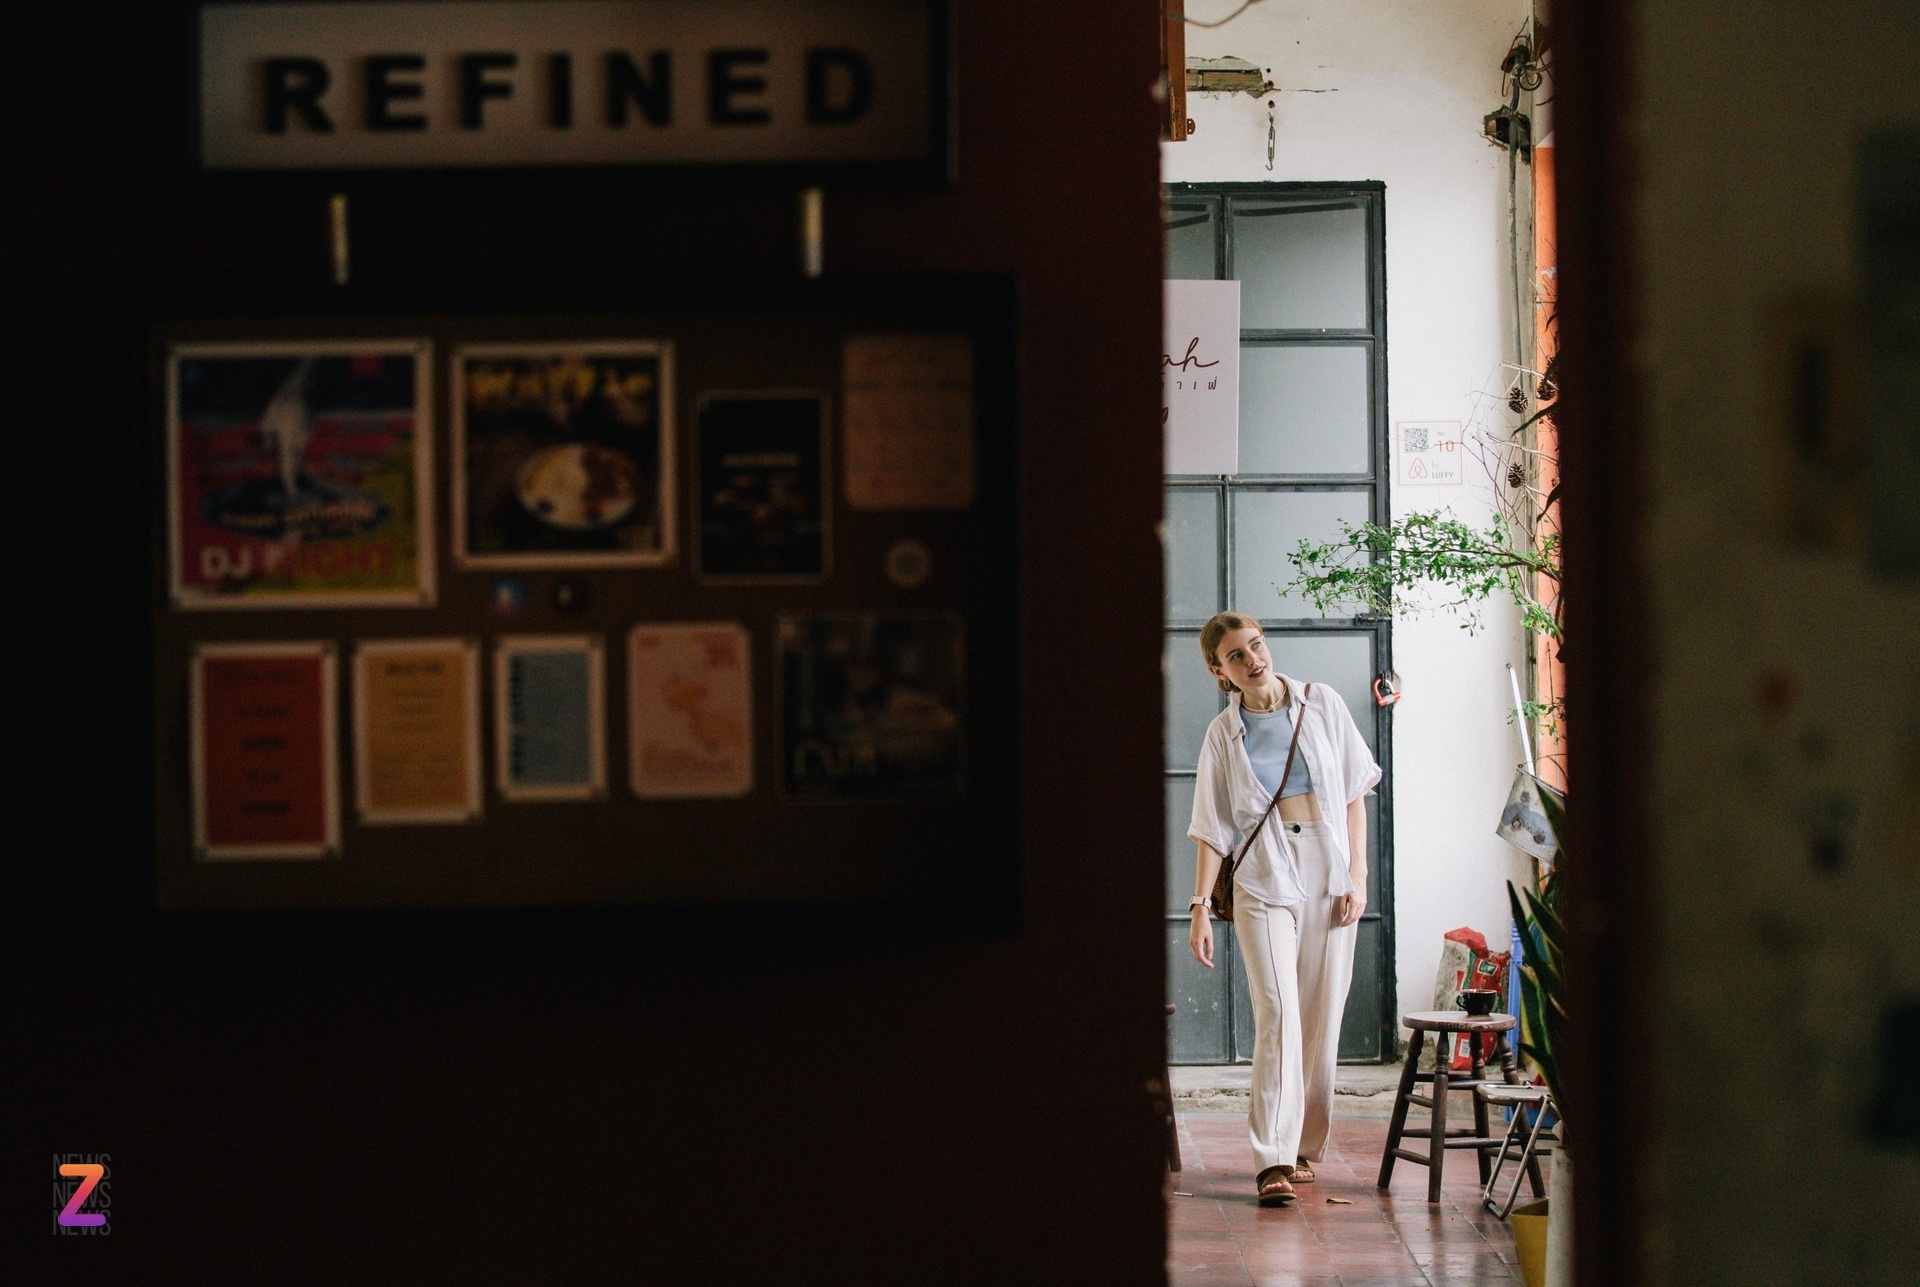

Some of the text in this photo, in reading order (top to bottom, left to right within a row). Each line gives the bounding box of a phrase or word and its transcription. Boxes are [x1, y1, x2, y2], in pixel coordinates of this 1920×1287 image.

[258, 47, 874, 133] REFINED
[1437, 440, 1455, 453] 10
[1431, 471, 1454, 479] LUFFY
[199, 545, 252, 580] DJ
